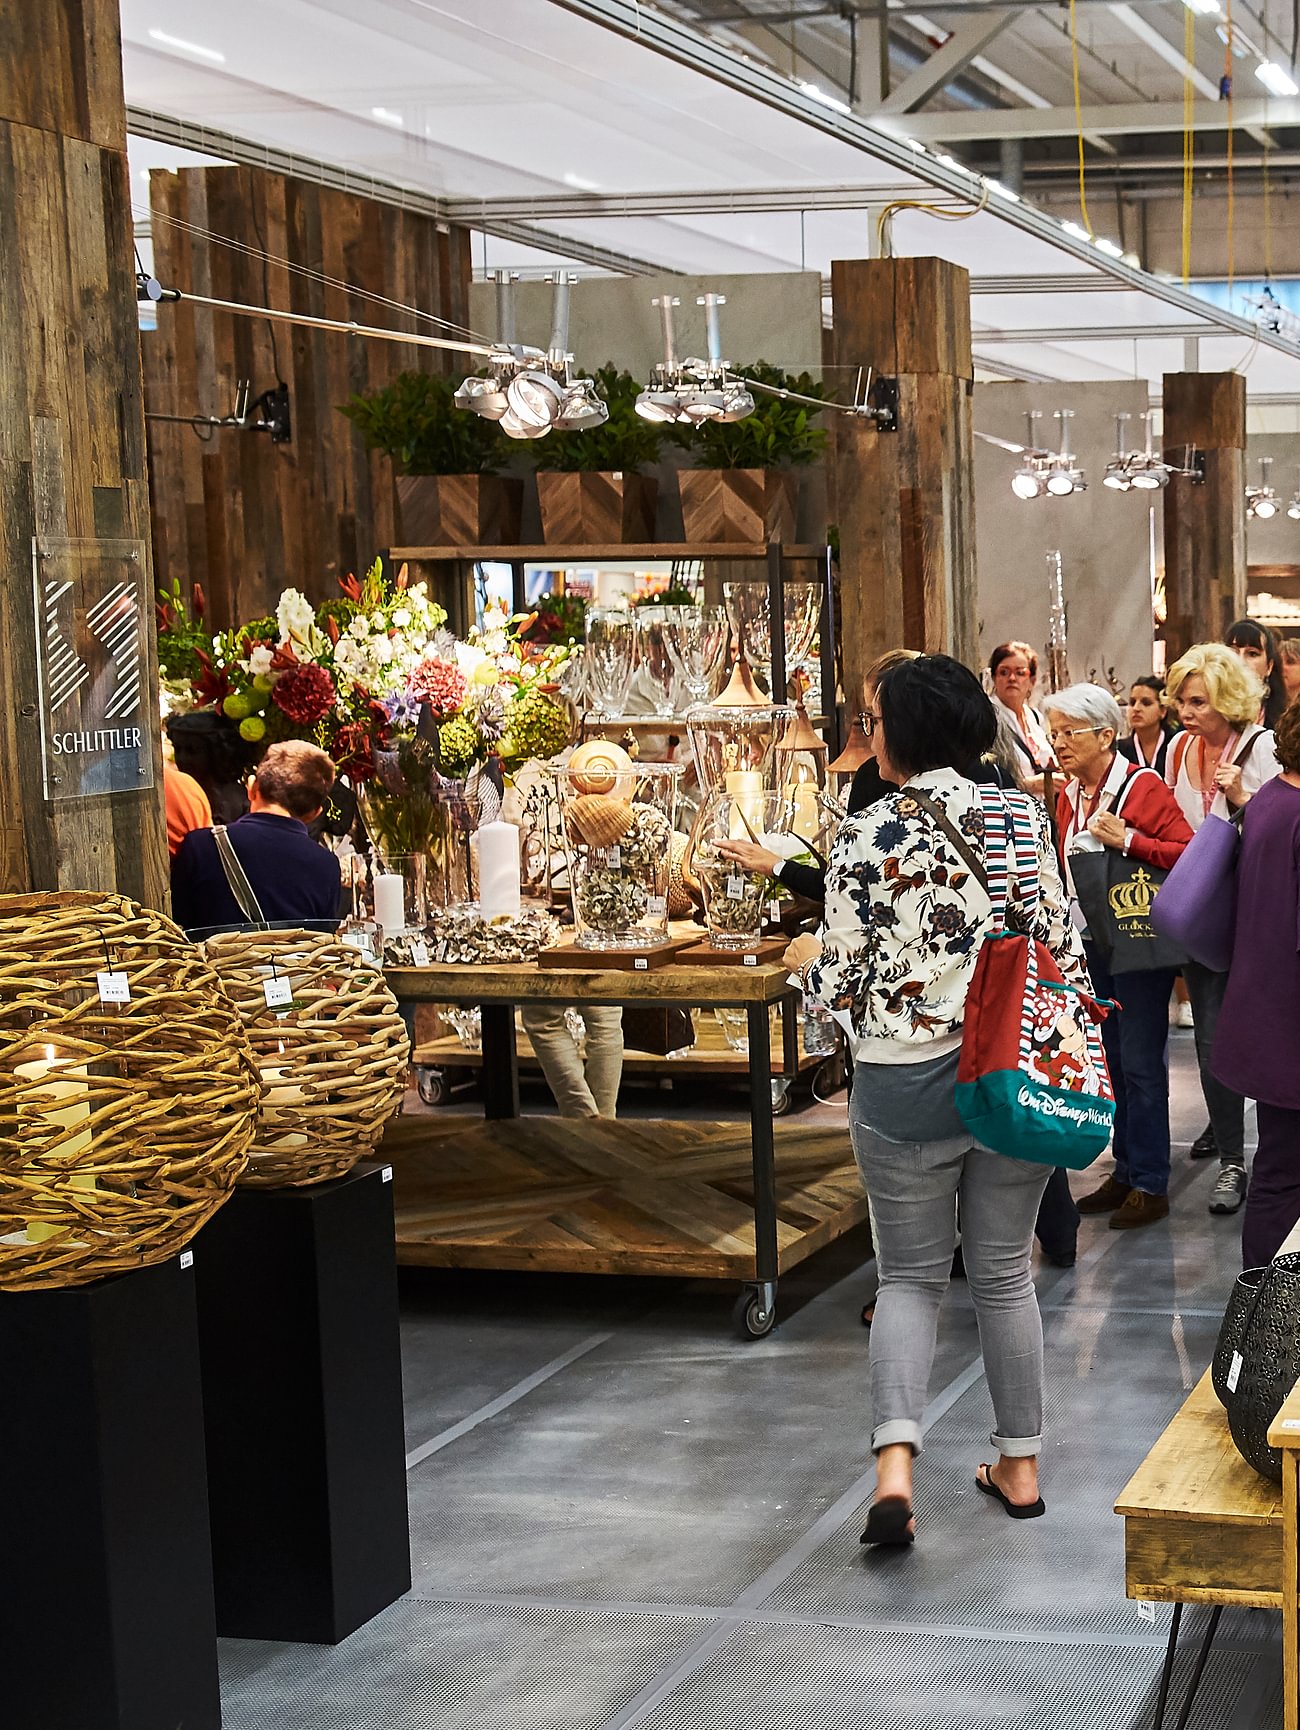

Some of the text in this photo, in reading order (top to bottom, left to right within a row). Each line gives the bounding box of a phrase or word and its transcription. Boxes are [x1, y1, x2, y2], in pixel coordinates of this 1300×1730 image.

[52, 727, 142, 755] SCHLITTLER
[1037, 1091, 1088, 1128] Disney
[1087, 1107, 1112, 1127] World
